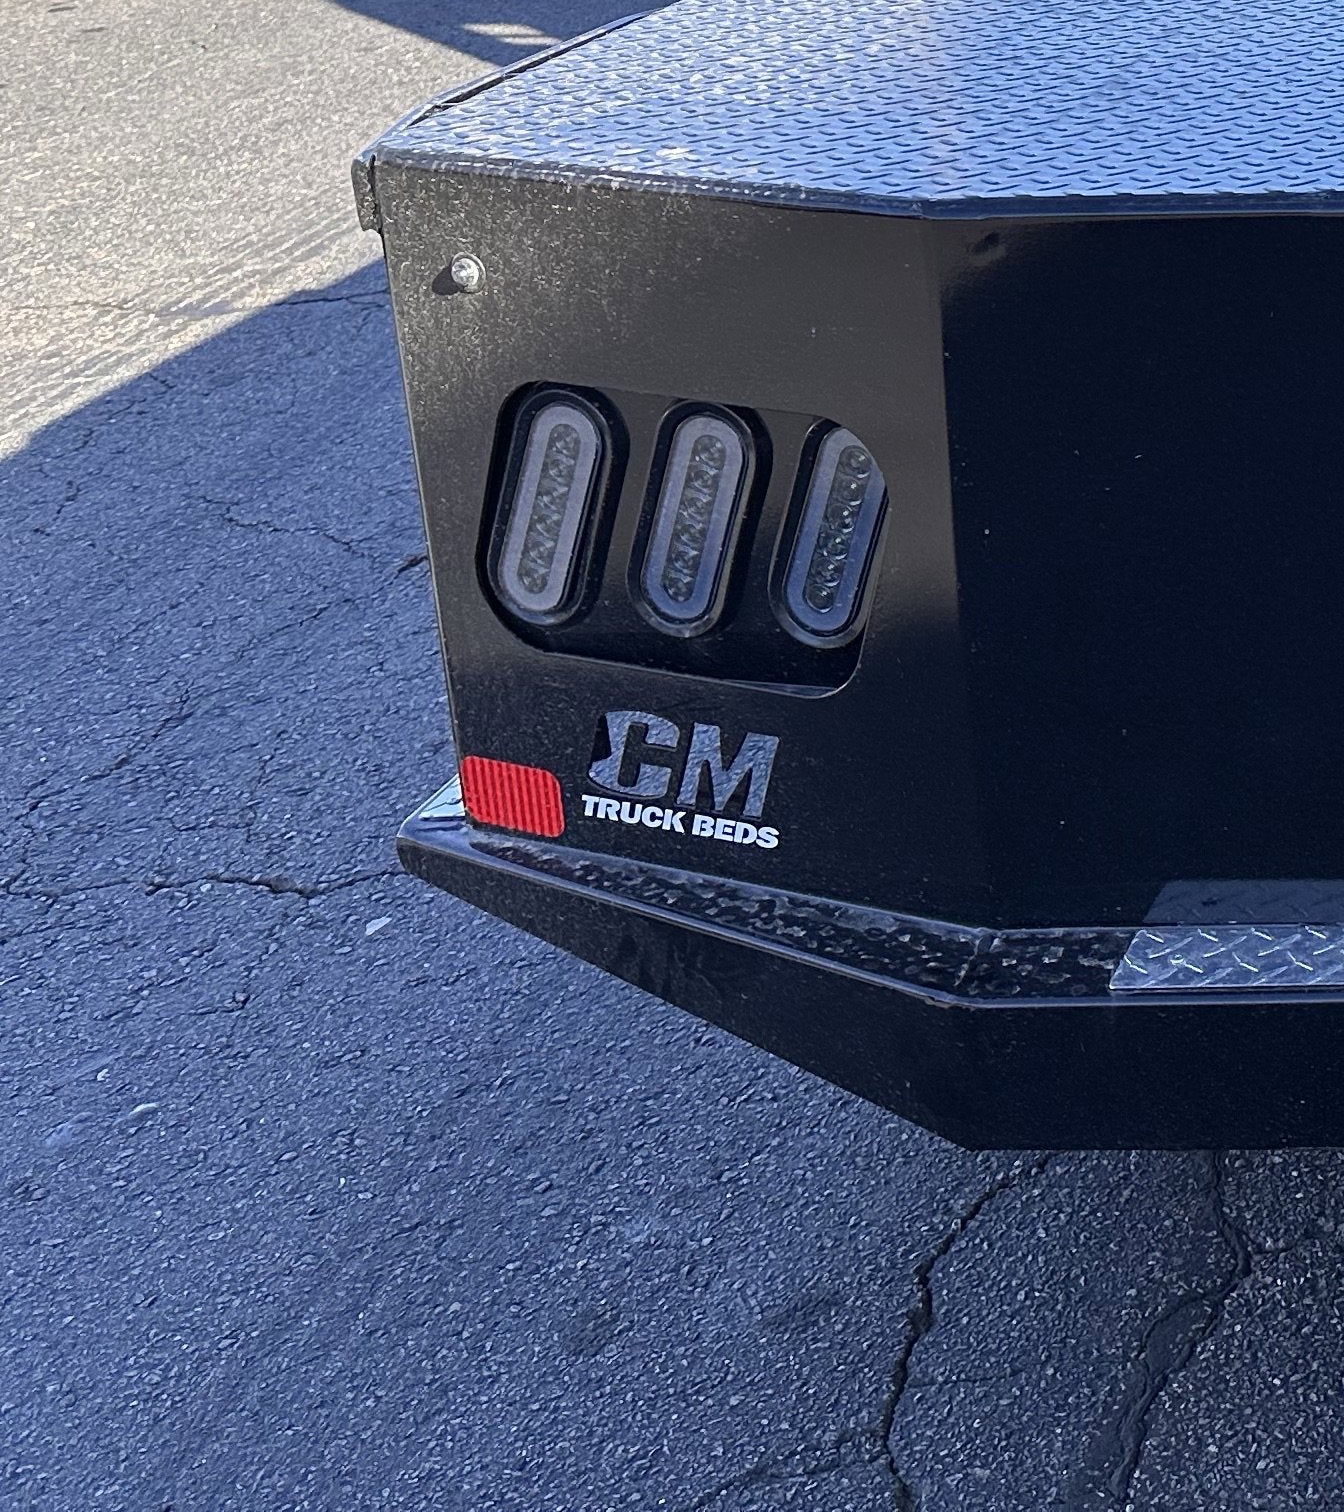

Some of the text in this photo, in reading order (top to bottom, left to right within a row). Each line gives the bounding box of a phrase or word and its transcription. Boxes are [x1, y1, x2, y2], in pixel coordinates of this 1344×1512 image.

[588, 710, 780, 819] CM
[581, 794, 780, 849] TRUCK BEDS
